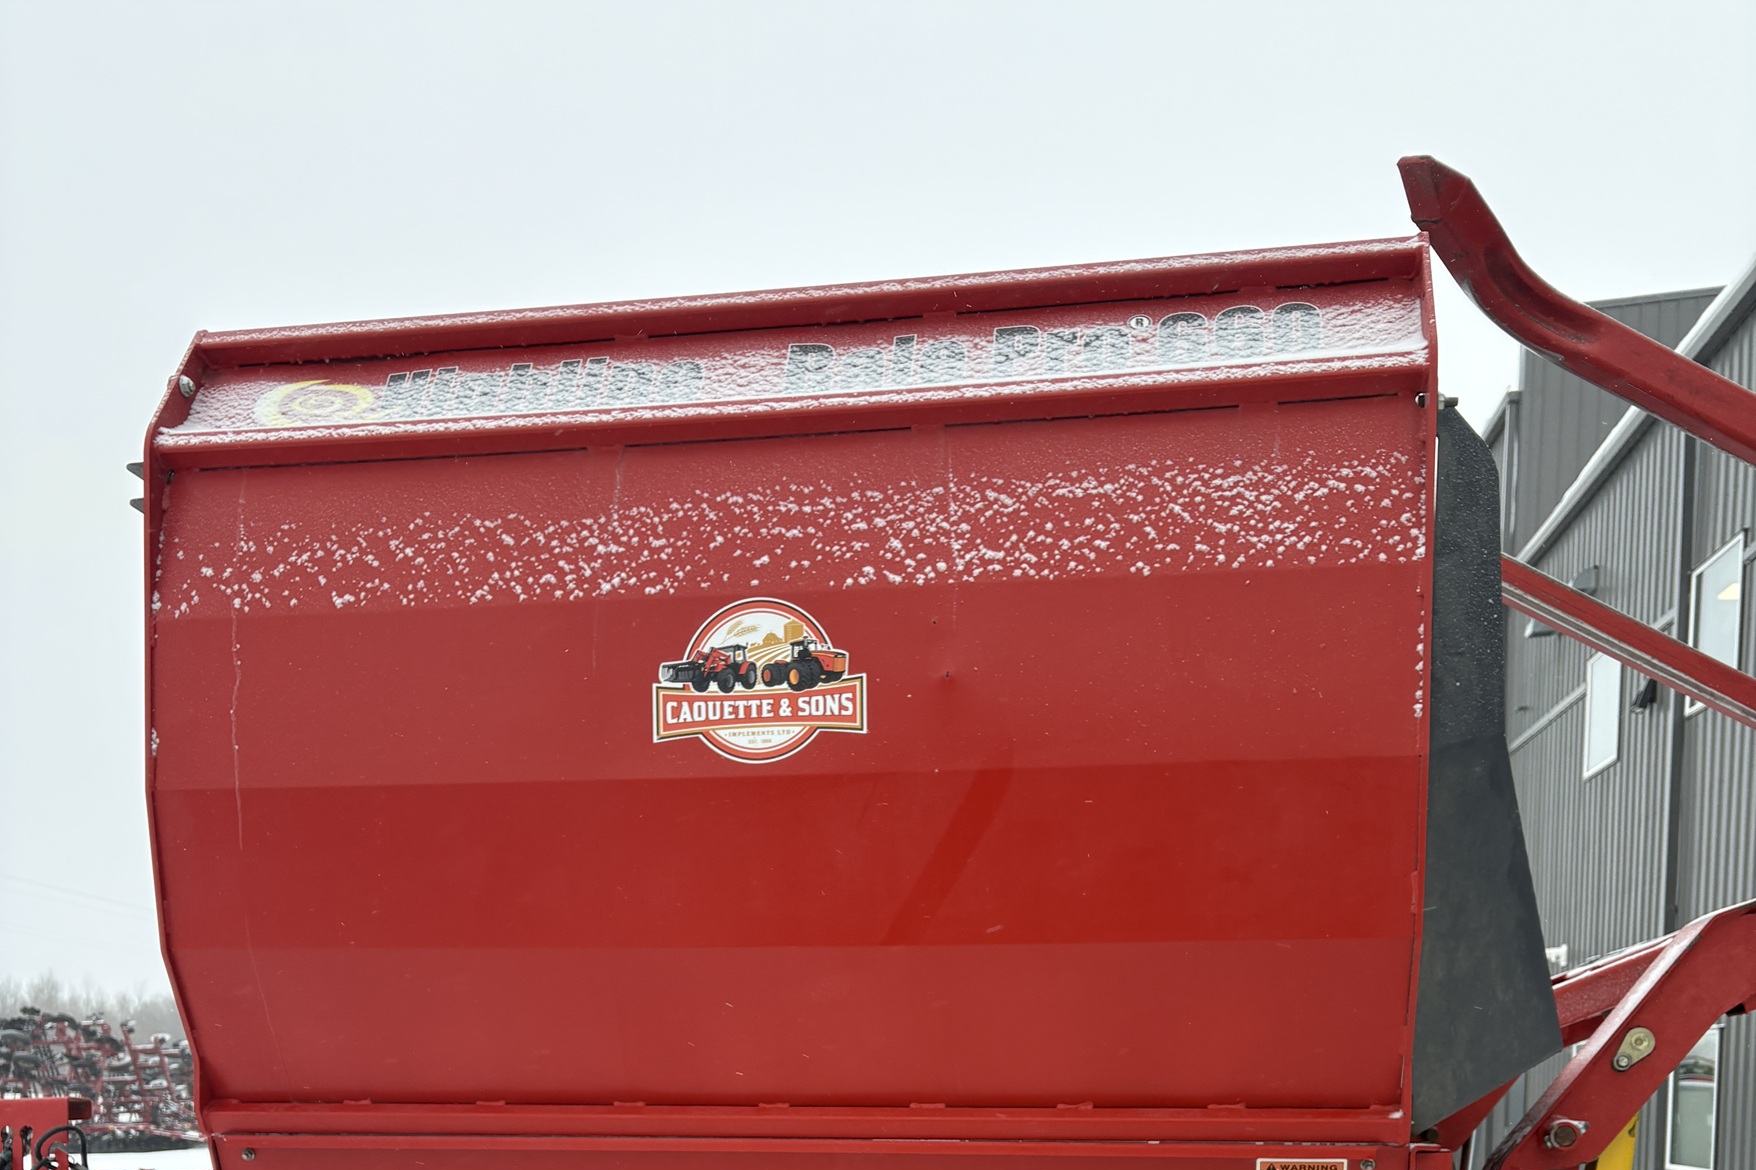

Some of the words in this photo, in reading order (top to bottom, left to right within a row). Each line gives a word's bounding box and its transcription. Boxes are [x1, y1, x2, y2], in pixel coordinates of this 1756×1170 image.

[1156, 302, 1323, 363] 660
[665, 698, 775, 725] CAOUETTE
[779, 697, 793, 717] &
[797, 692, 854, 716] SONS
[728, 730, 776, 738] IMPLEMENTS
